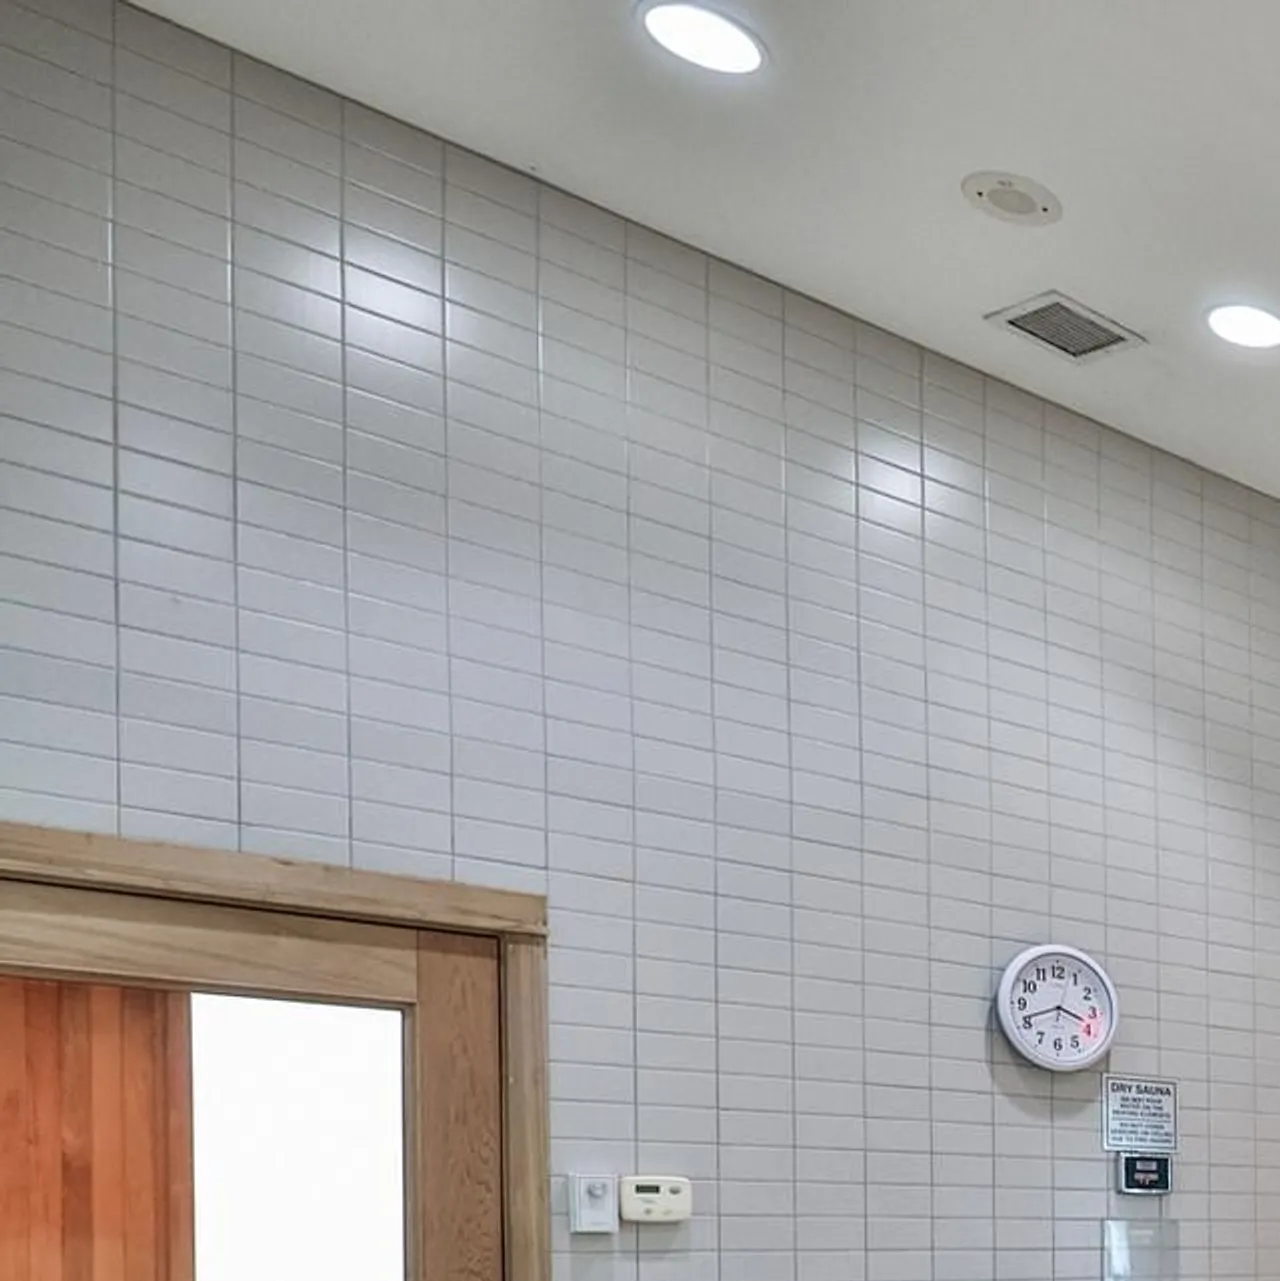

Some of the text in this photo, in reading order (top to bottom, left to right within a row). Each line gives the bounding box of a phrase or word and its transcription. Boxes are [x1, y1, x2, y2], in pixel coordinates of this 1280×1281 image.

[1036, 967, 1046, 981] 11
[1052, 965, 1065, 980] 12
[1072, 972, 1078, 986] 1
[1022, 979, 1037, 994] 10
[1083, 986, 1091, 1001] 2
[1018, 997, 1027, 1011] 9
[1088, 1006, 1097, 1019] 3
[1083, 1023, 1091, 1036] 4
[1036, 1031, 1045, 1045] 7
[1053, 1038, 1062, 1051] 6
[1070, 1035, 1079, 1048] 5
[1110, 1082, 1172, 1096] DRY SAUNA
